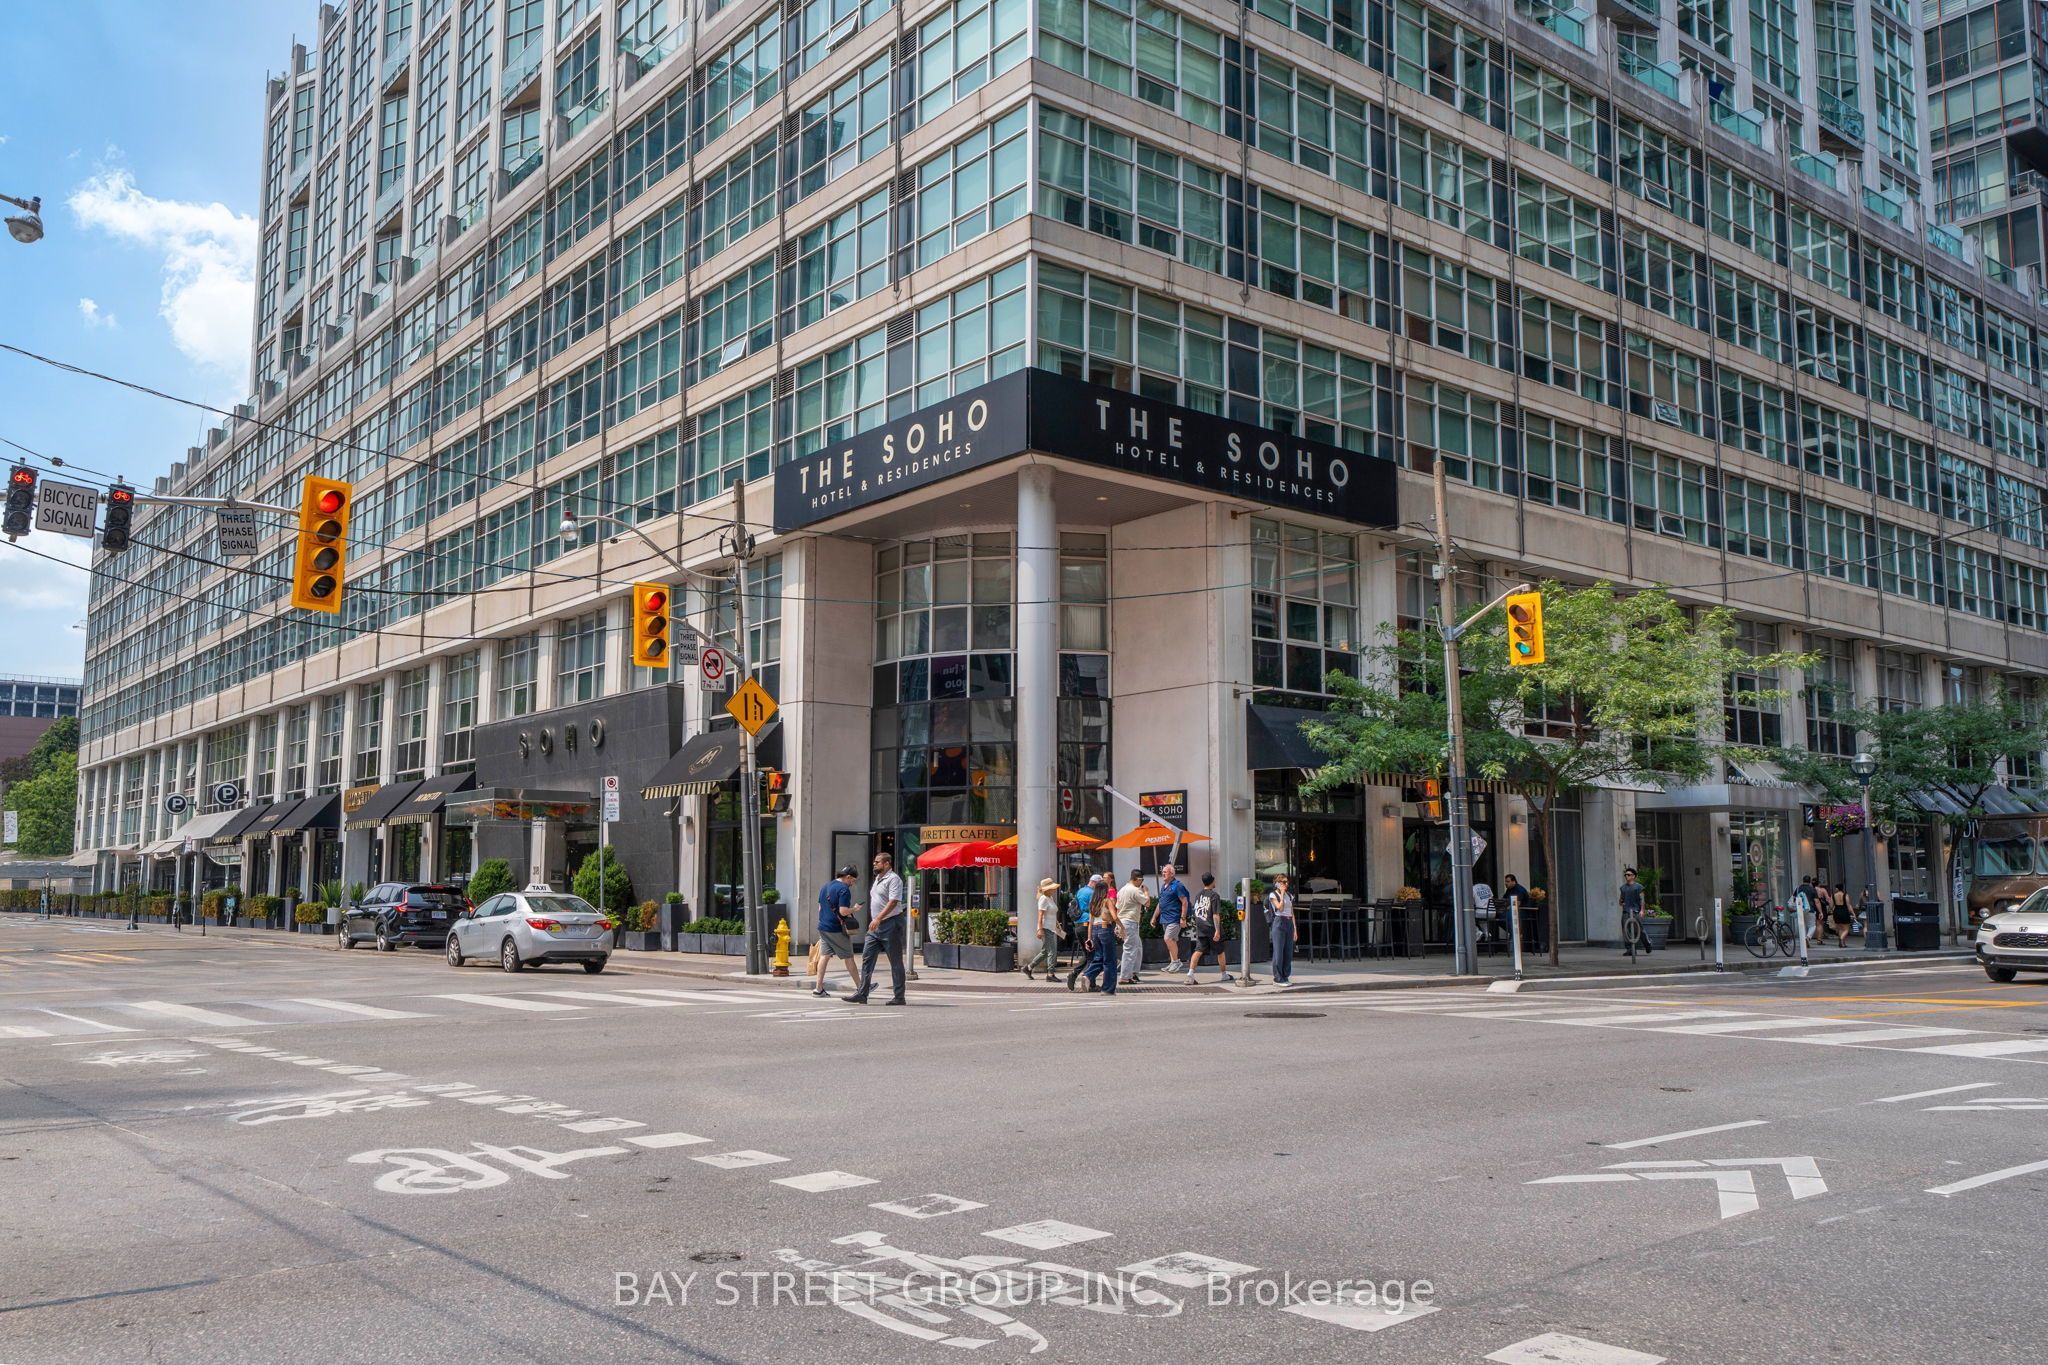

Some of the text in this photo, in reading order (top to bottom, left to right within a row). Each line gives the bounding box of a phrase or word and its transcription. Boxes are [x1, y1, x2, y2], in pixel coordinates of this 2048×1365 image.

[800, 399, 988, 494] THE SOHO
[1096, 398, 1349, 487] THE SOHO
[812, 442, 972, 509] HOTEL & RESIDENCES
[1115, 442, 1334, 503] HOTEL & RESIDENCES
[43, 488, 95, 511] BICYCLE
[42, 508, 90, 530] SIGNAL
[221, 514, 252, 524] THREE
[221, 527, 253, 537] PHASE
[222, 540, 256, 550] SIGNAL
[680, 633, 696, 641] THREE
[519, 718, 605, 759] SOHO
[1158, 805, 1183, 815] SOHO
[922, 829, 998, 840] ORETTI CAFFE
[974, 856, 1001, 864] MORETTI
